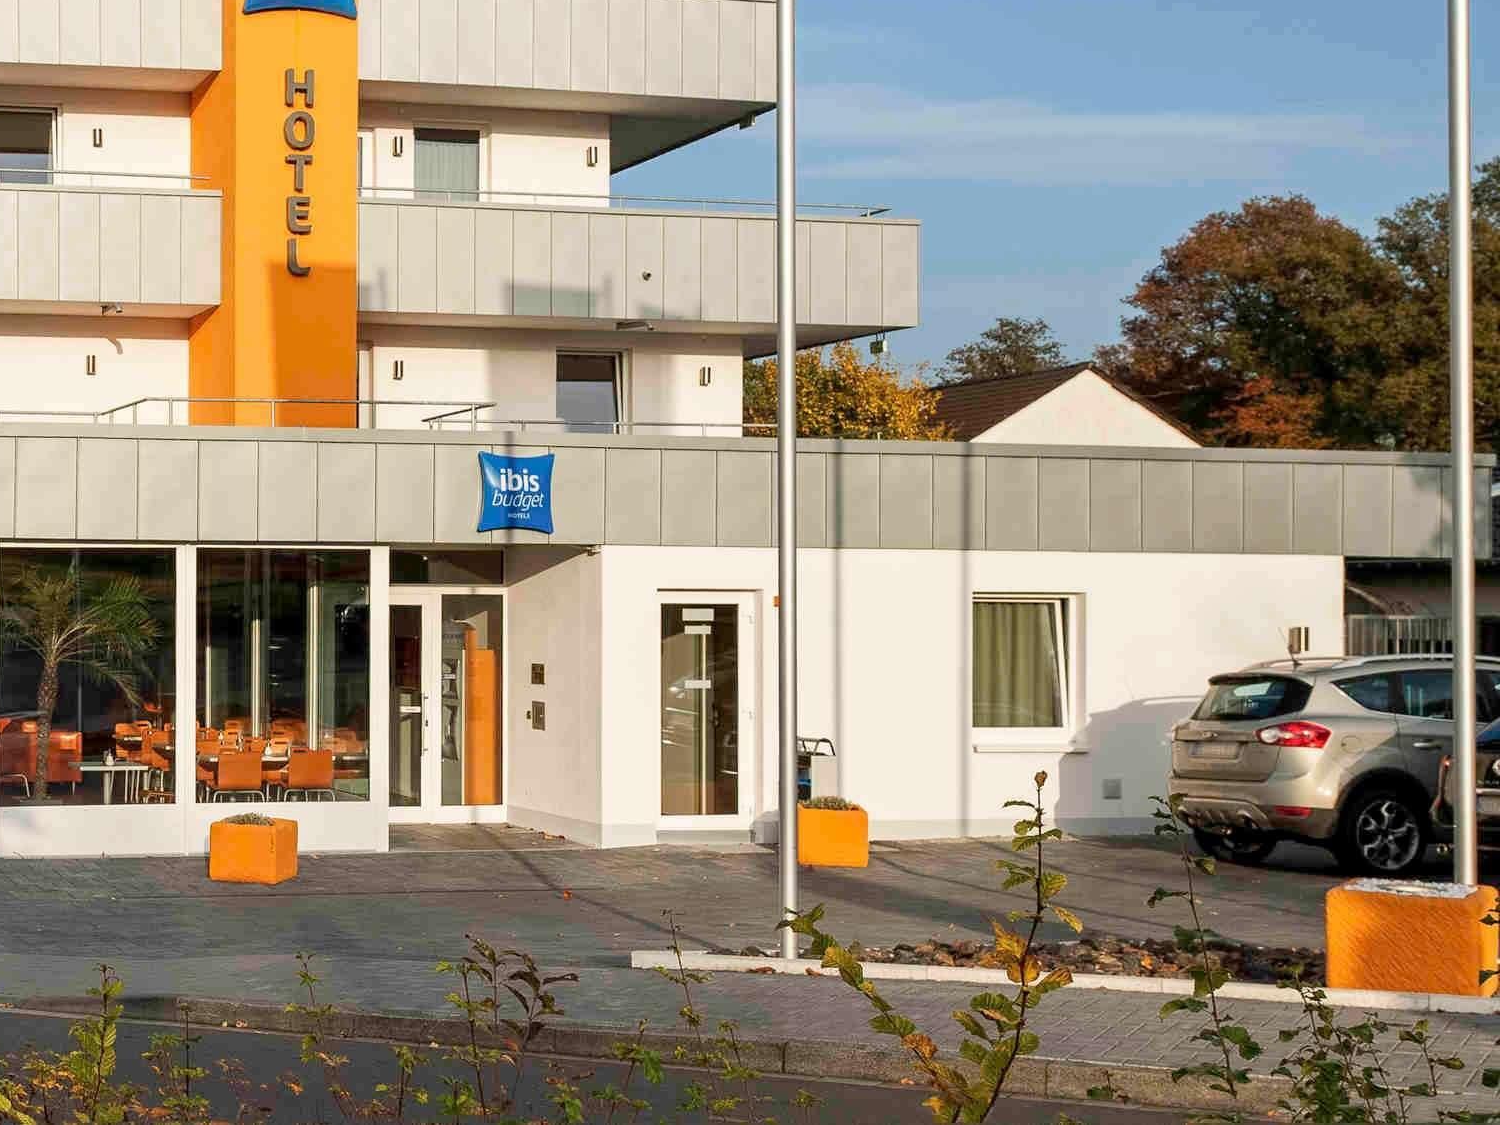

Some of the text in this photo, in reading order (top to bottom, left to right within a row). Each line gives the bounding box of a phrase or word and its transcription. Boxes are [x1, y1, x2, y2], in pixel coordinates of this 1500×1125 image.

[284, 68, 315, 278] HOTEL
[499, 467, 540, 492] ibis
[491, 489, 545, 512] budget
